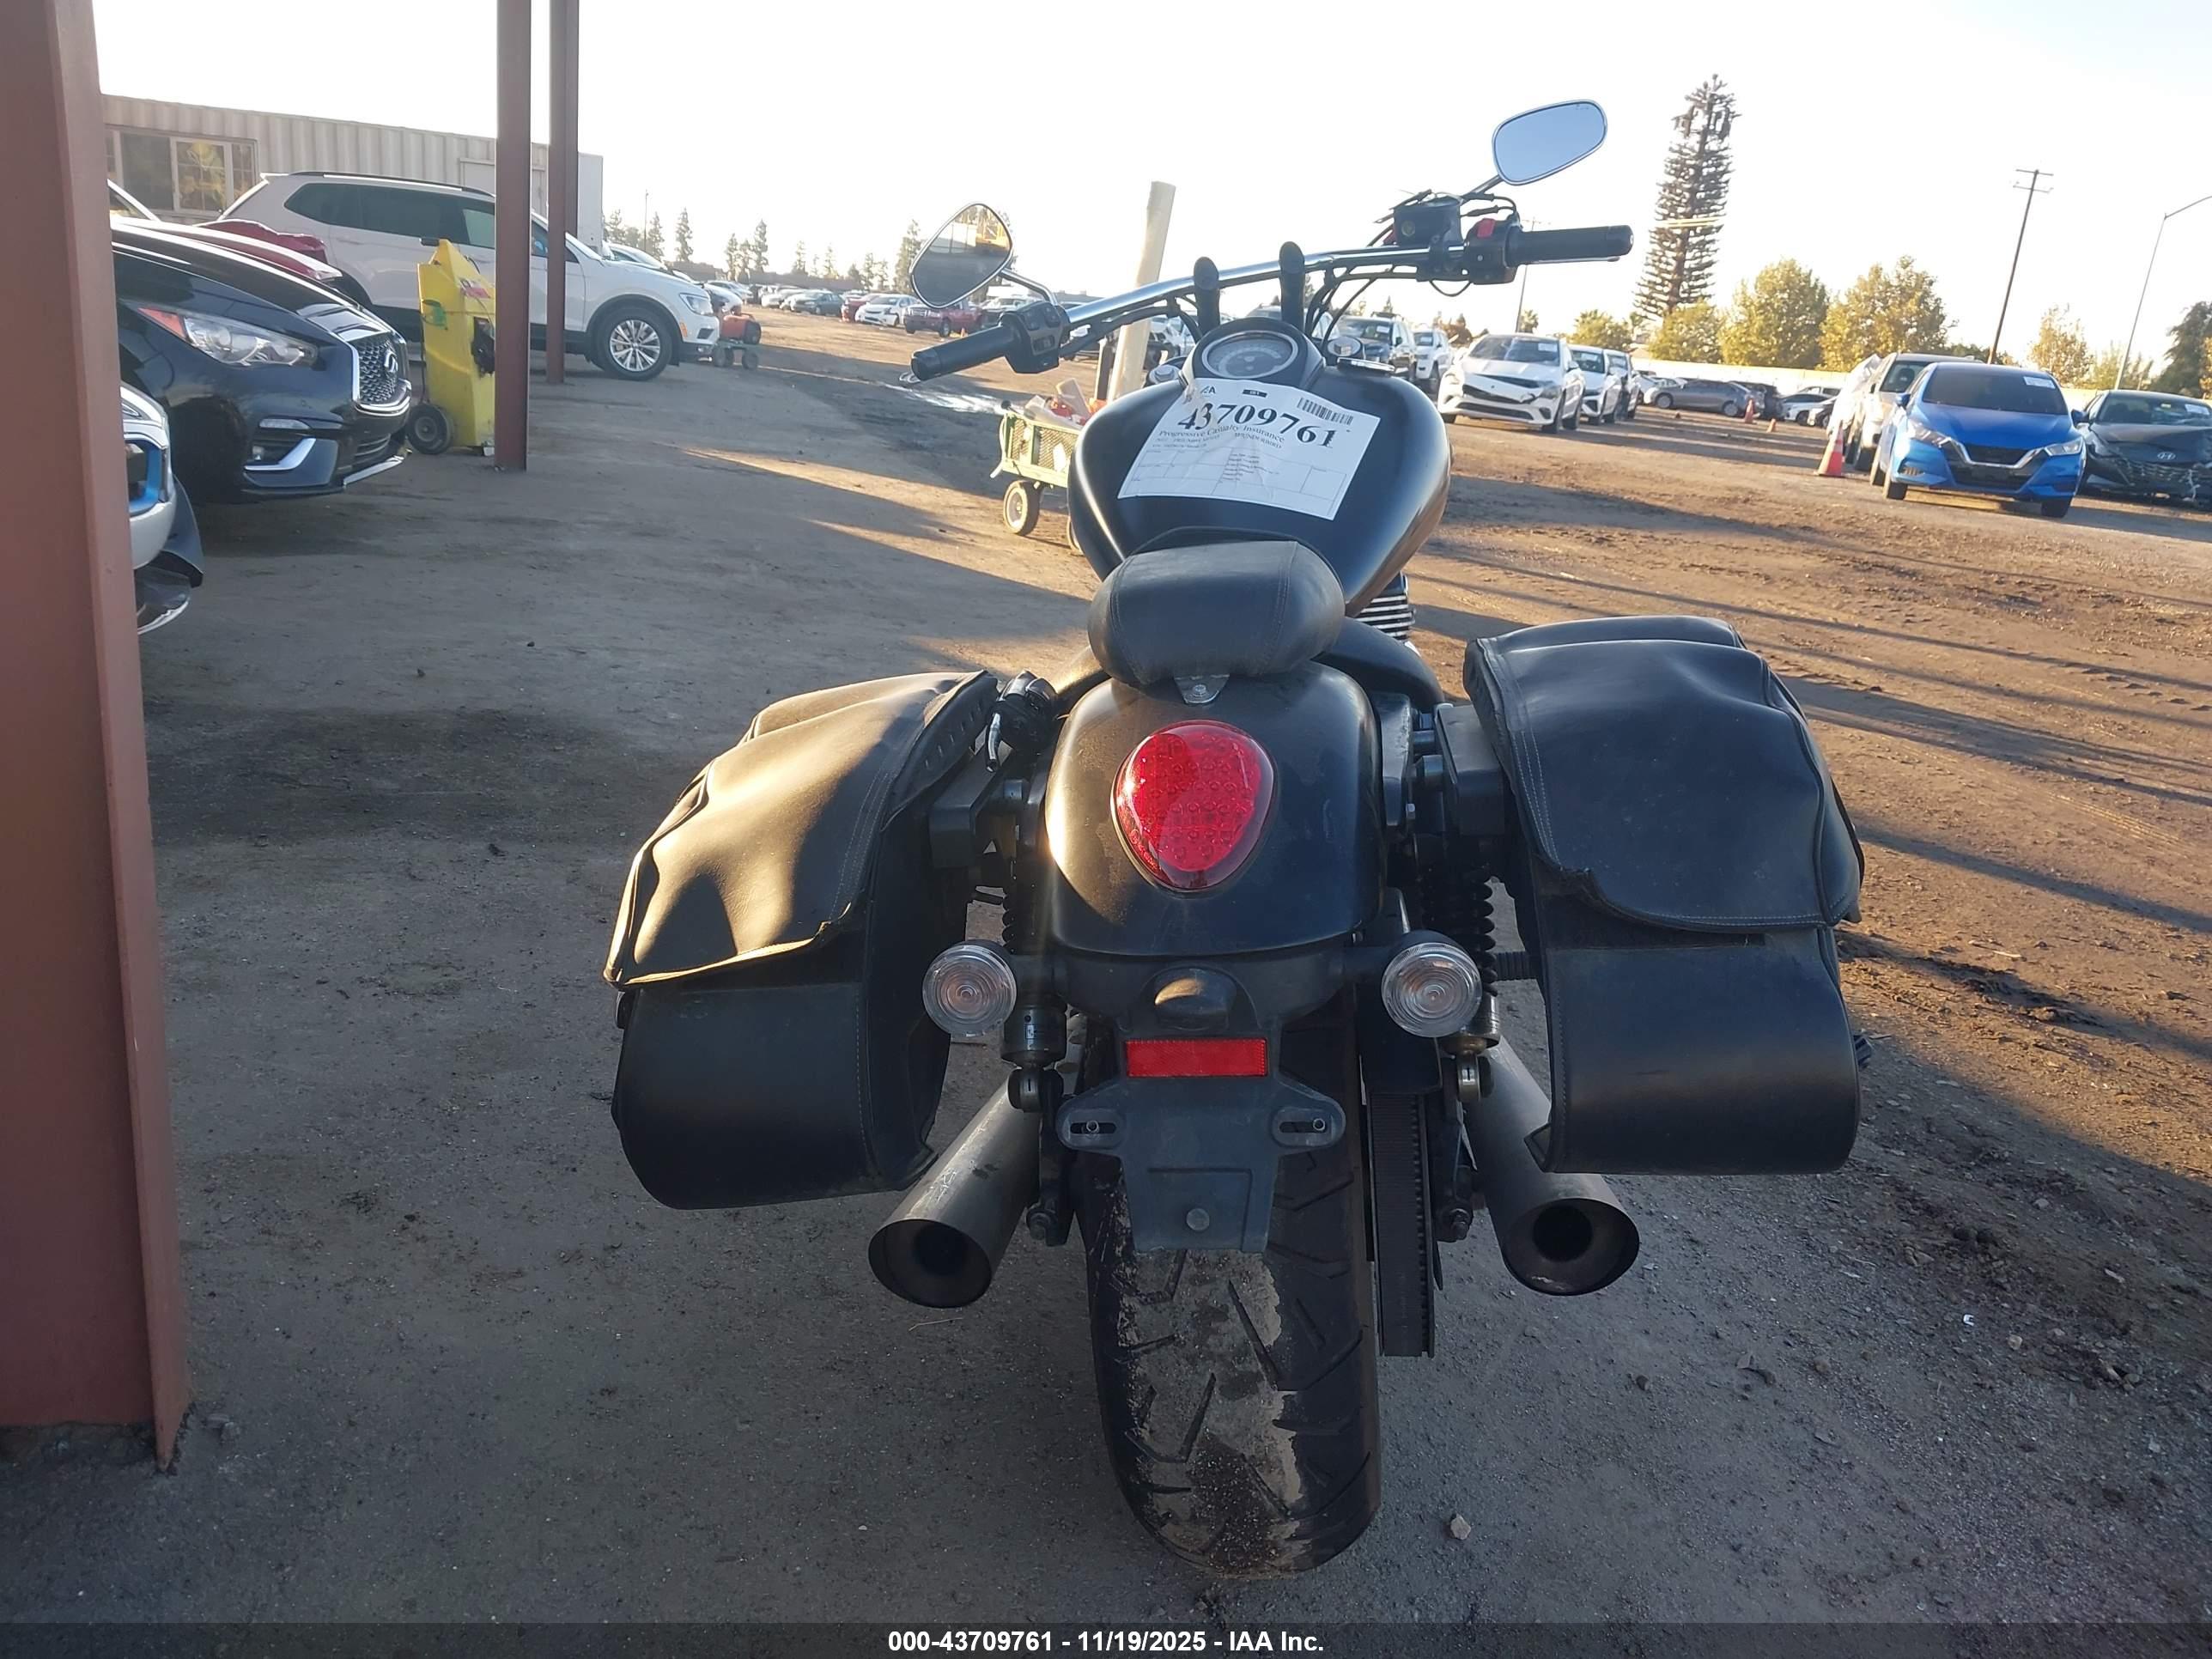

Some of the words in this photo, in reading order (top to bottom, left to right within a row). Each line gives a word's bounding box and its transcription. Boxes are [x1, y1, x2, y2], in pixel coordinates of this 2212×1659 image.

[1177, 402, 1338, 449] 43709761
[1206, 424, 1239, 436] Casualty
[1243, 425, 1285, 443] Insurance
